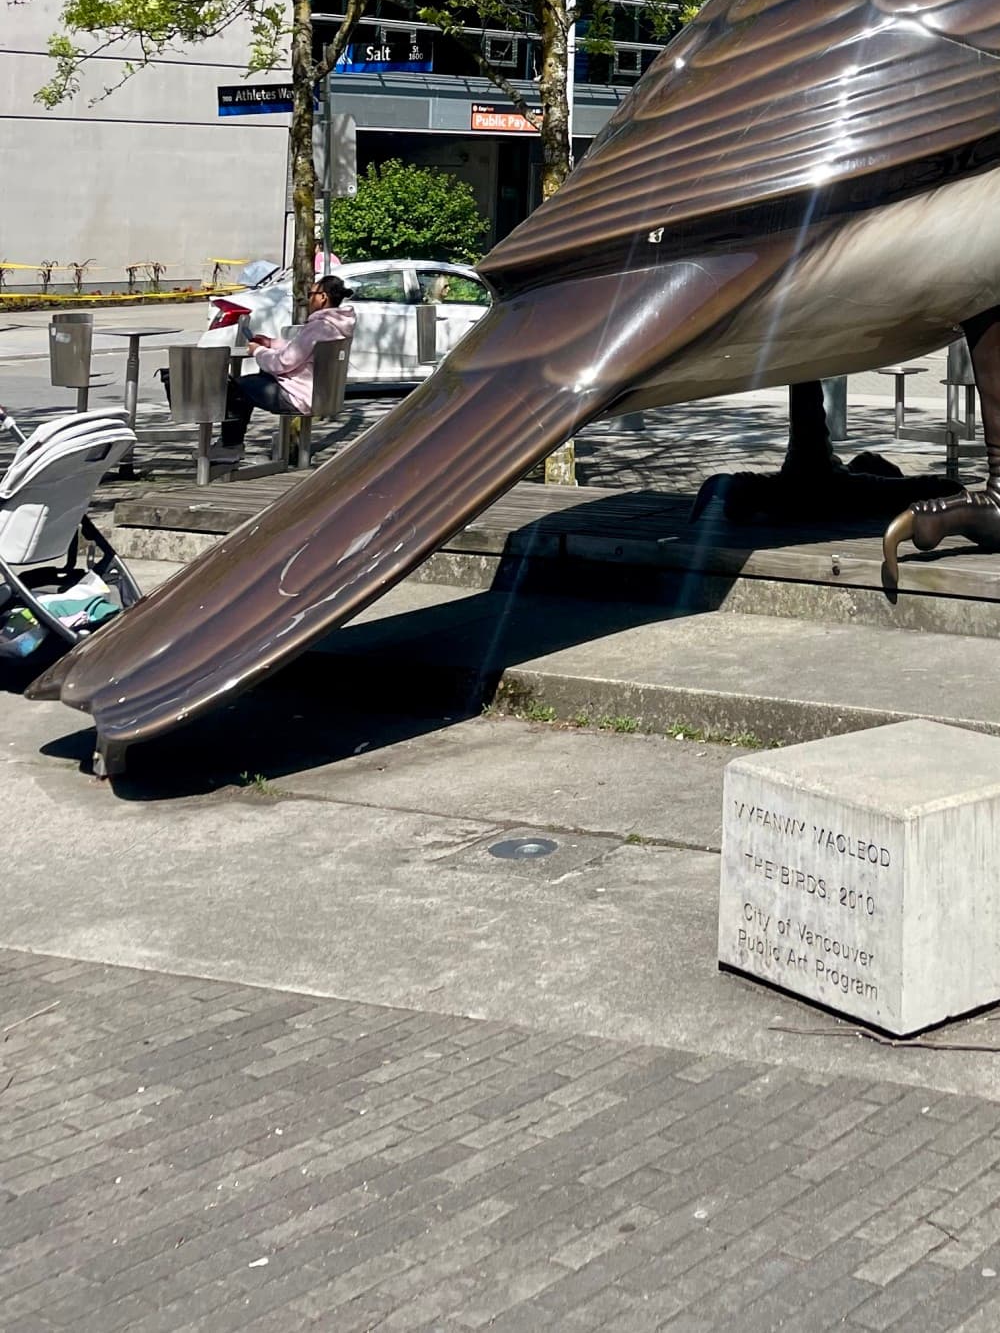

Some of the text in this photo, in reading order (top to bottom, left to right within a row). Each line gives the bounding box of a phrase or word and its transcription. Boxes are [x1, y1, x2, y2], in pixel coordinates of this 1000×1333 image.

[366, 45, 391, 61] Salt
[235, 88, 277, 102] Athletes
[475, 114, 507, 128] Public
[508, 116, 527, 131] Pay
[744, 852, 776, 880] THE
[839, 886, 875, 916] 2010
[743, 902, 874, 967] City of Vancouver
[738, 928, 878, 1001] Public Art Program
